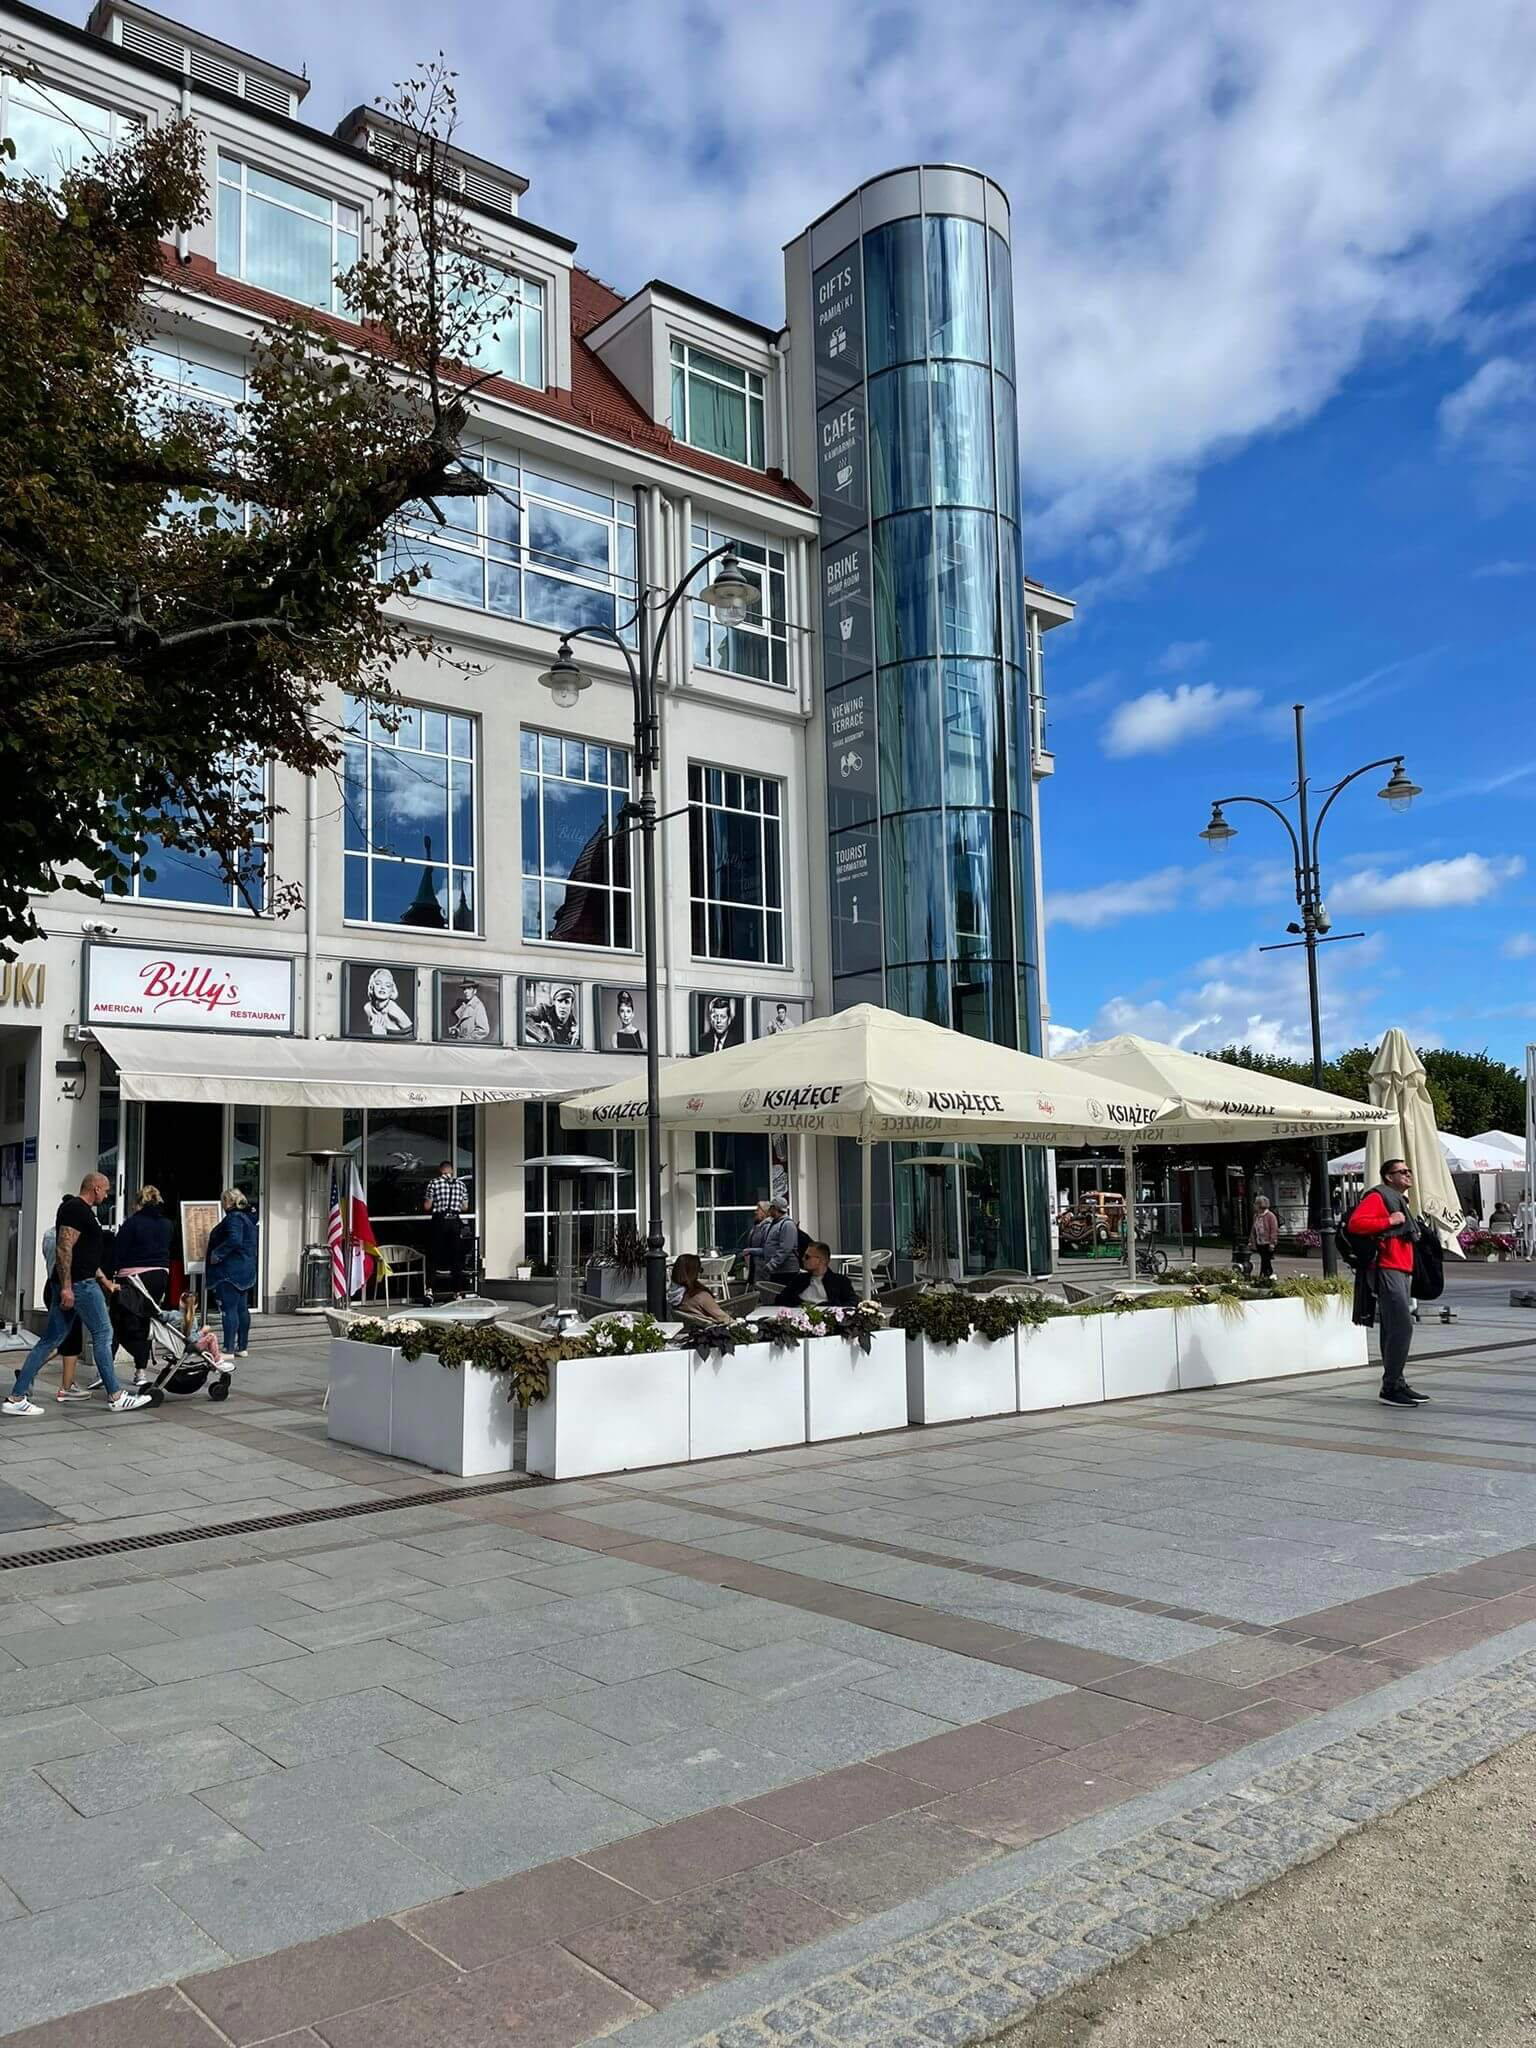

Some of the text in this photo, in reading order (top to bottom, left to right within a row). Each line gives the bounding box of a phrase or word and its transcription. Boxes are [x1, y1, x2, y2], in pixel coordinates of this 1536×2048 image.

[819, 266, 852, 304] GIFTS
[823, 407, 856, 447] CAFE
[827, 551, 859, 584] BRINE
[831, 695, 864, 719] VIEWING
[831, 711, 864, 735] TERRACE
[835, 843, 867, 865] TOURIST
[138, 961, 240, 1011] Billy's
[93, 1004, 143, 1014] AMERICAN
[229, 1010, 286, 1021] RESTAURANT
[762, 1084, 843, 1110] KSIĄŻĘCE
[927, 1091, 1005, 1115] KSIĄŻĘCE
[592, 1100, 649, 1122] KSIĄŻĘC
